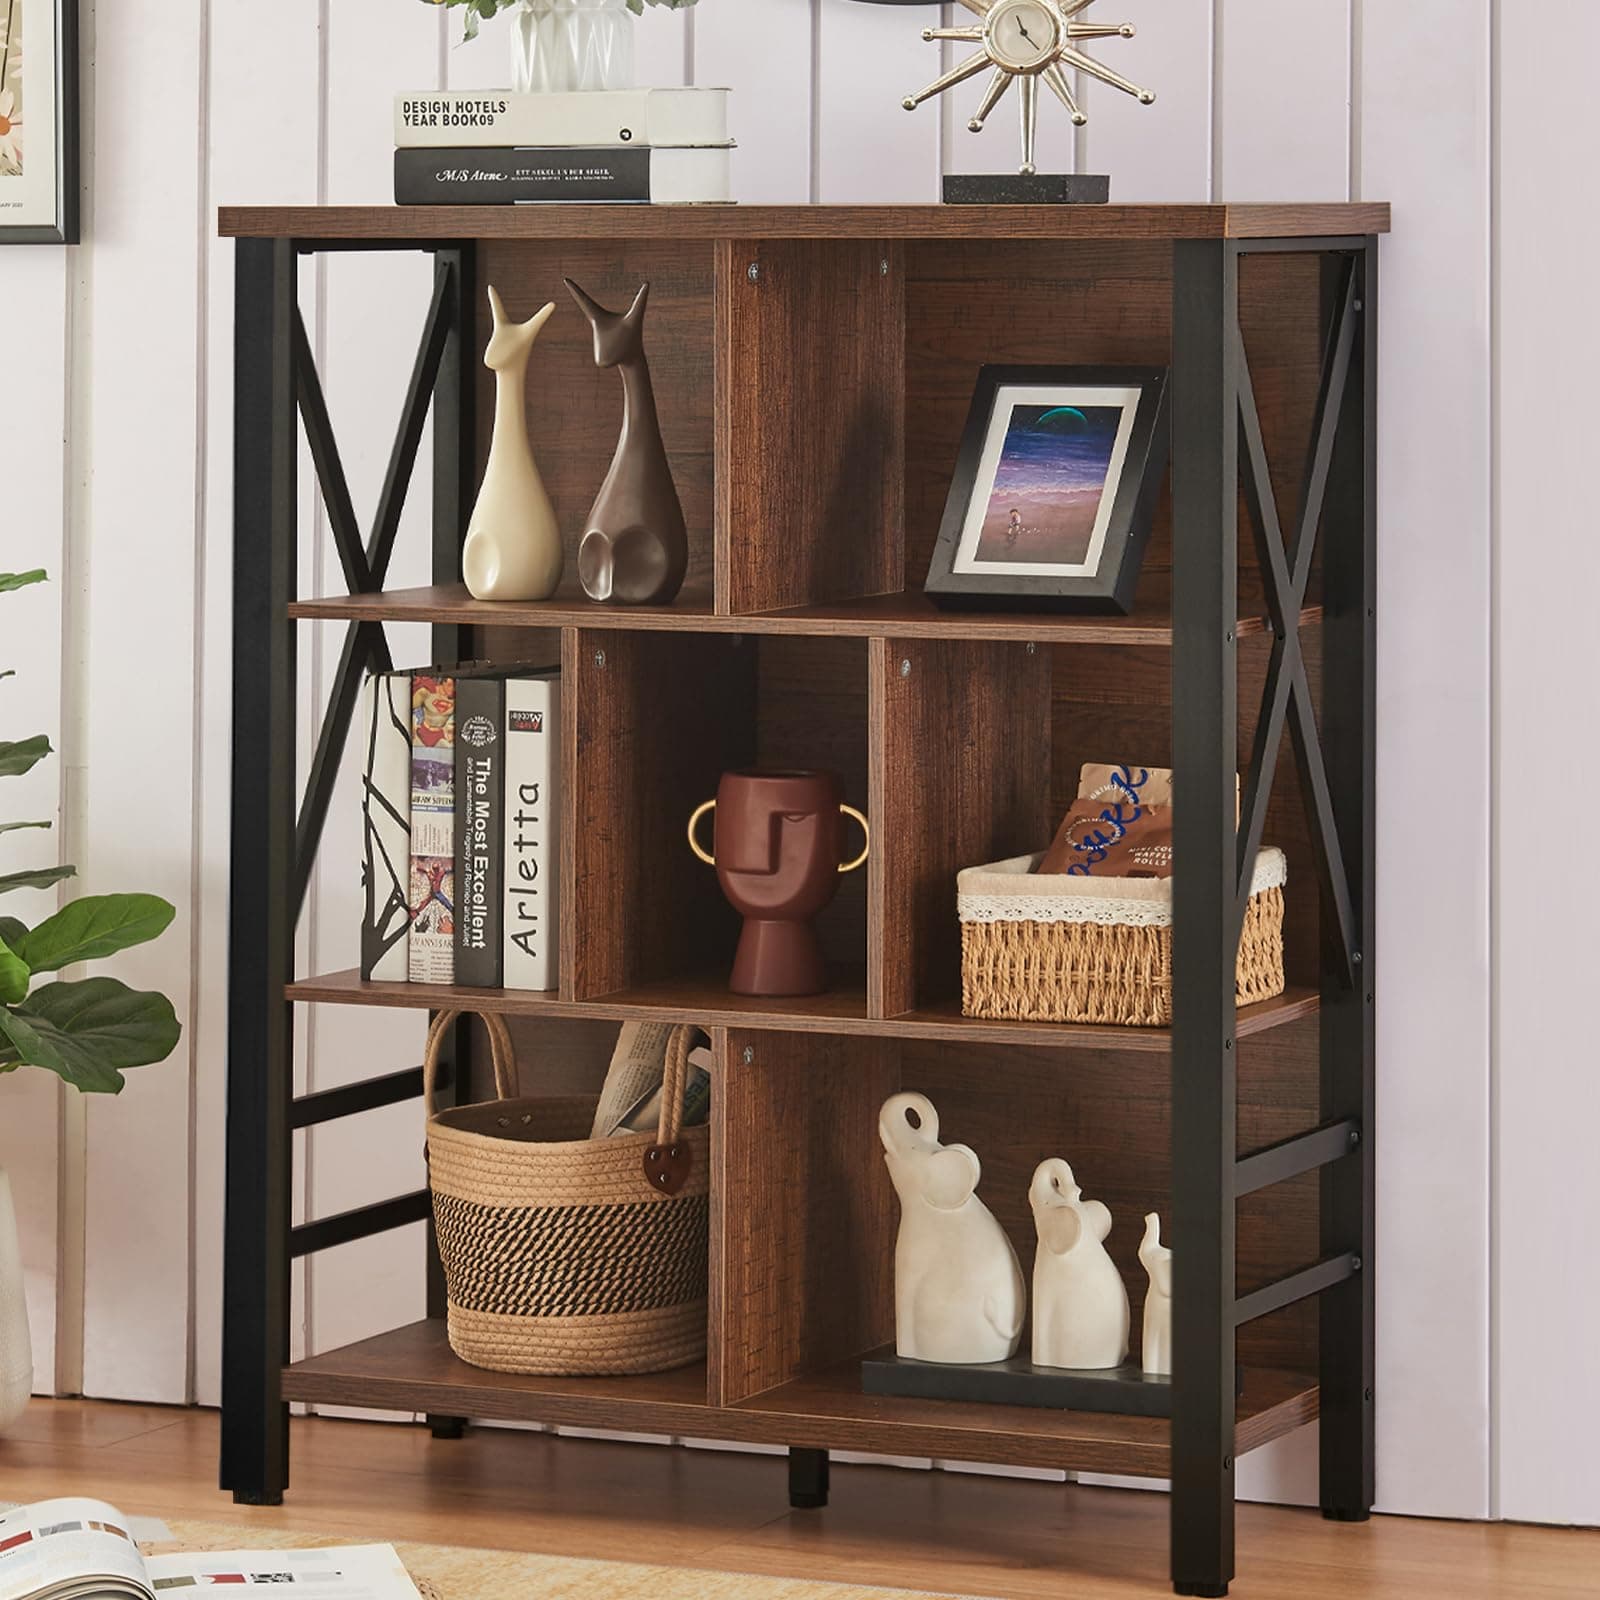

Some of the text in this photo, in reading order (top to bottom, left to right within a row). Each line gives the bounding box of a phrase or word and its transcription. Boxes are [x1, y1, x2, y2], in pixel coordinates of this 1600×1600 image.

[403, 101, 506, 113] DESIGN HOTELS
[403, 114, 437, 126] YEAR
[435, 169, 469, 182] M/S
[470, 170, 508, 181] Atene
[475, 757, 491, 795] The
[474, 801, 490, 850] Most
[462, 757, 474, 947] and Lamentable Tragedy of Romeo and Juliet
[509, 783, 539, 958] Arletta
[1132, 857, 1168, 866] ROLLS
[472, 855, 489, 949] Excellent
